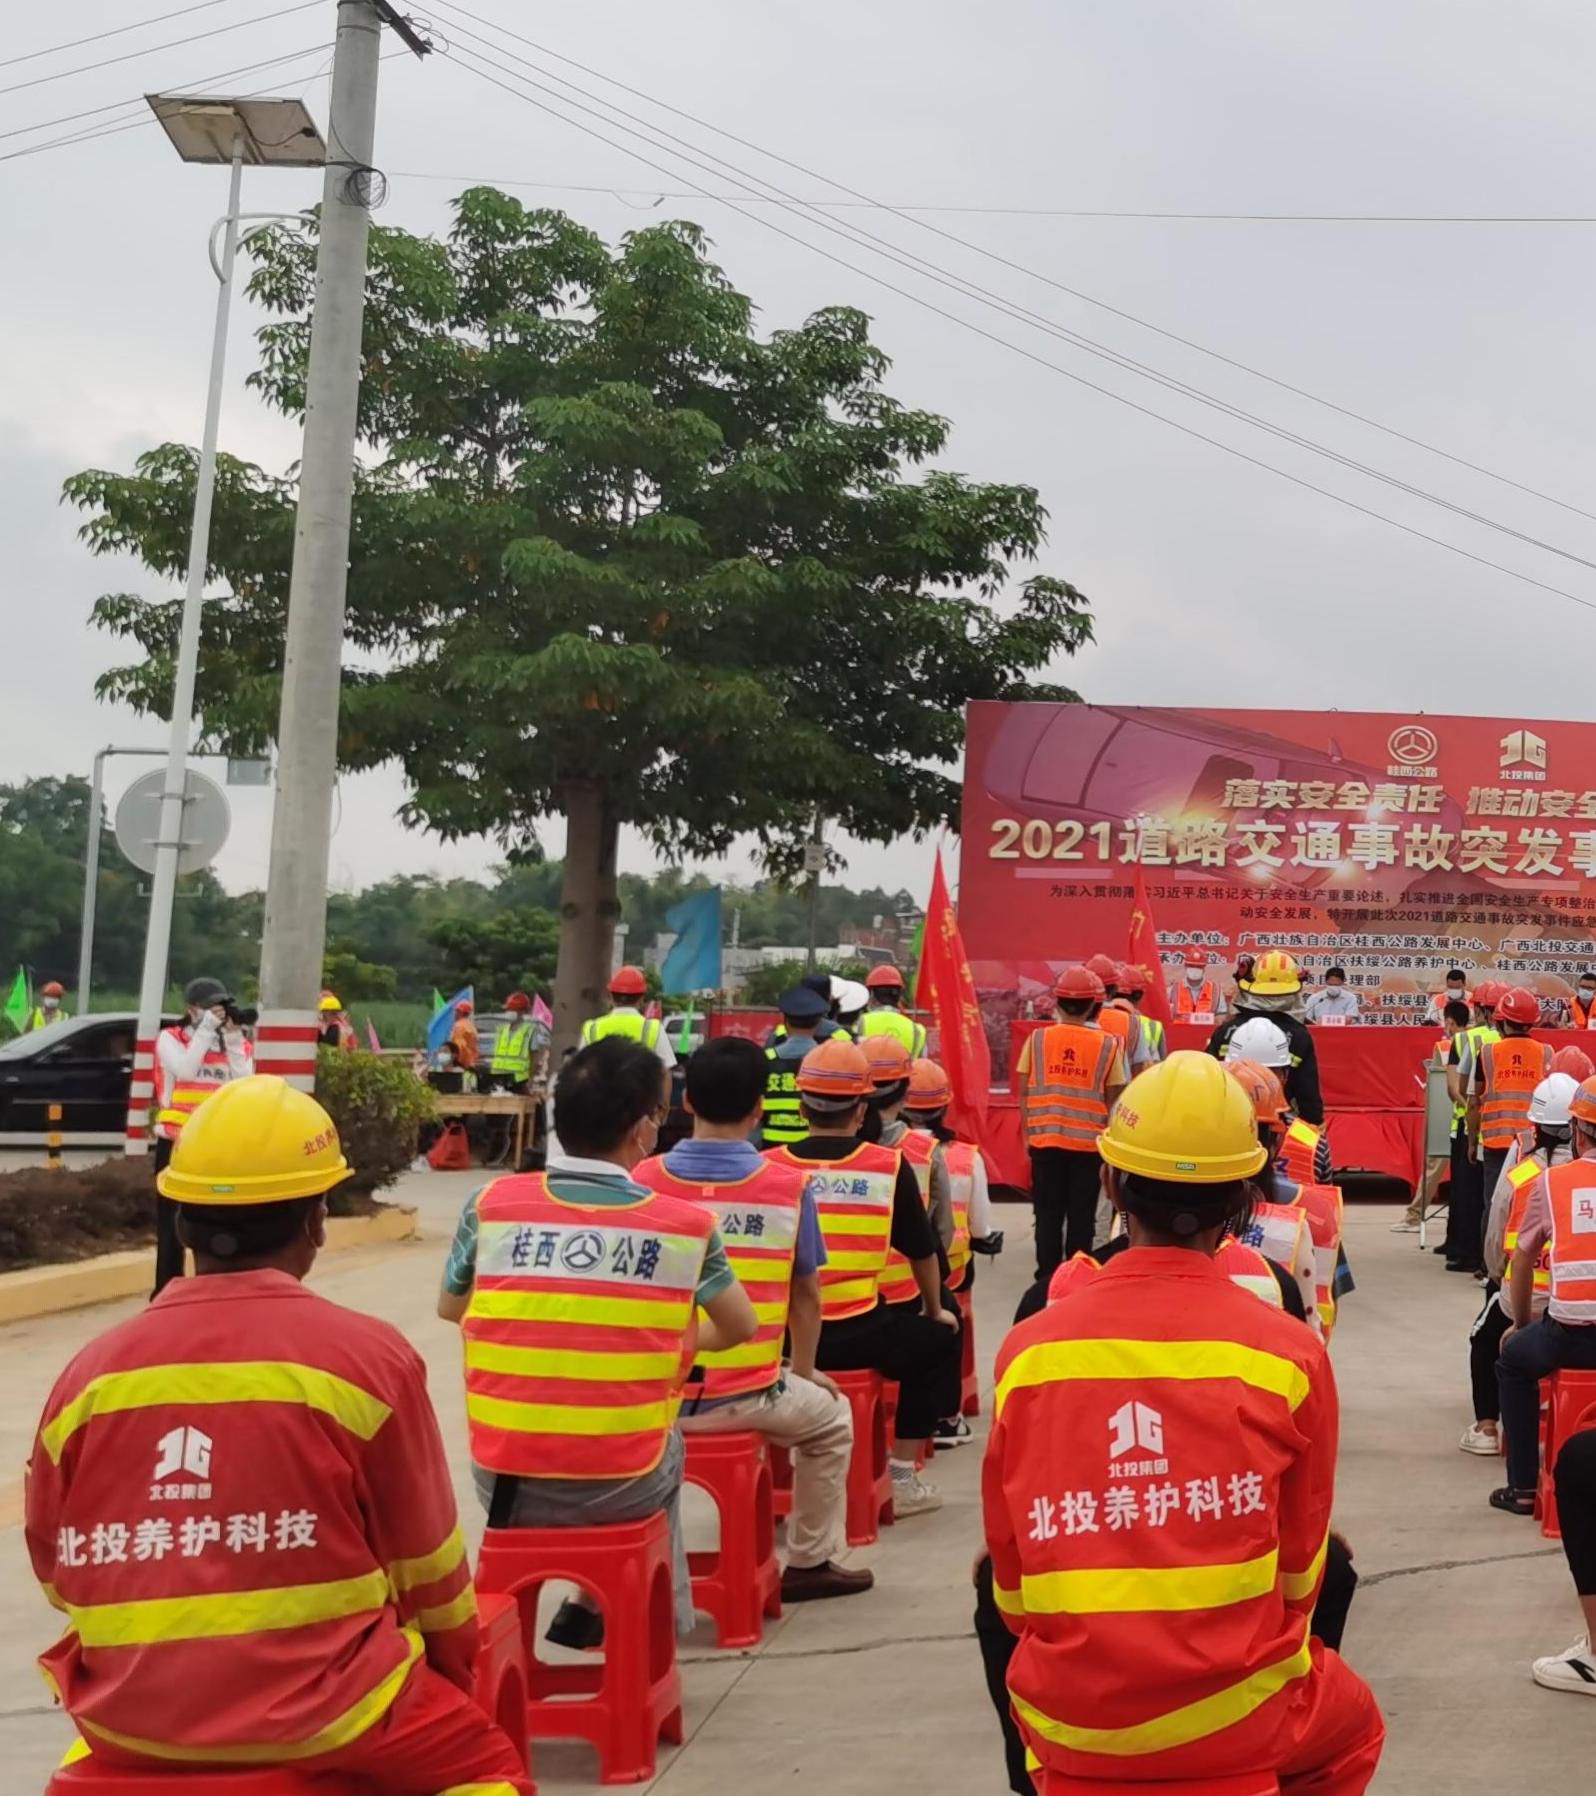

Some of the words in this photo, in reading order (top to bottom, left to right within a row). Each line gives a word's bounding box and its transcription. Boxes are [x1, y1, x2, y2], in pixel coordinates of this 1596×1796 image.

[1387, 765, 1438, 778] 桂西公路
[1499, 769, 1547, 782] 北投集团
[1221, 779, 1445, 813] 落实安全责任
[832, 1178, 870, 1196] 公路
[722, 1212, 766, 1238] 公路
[511, 1230, 561, 1269] 桂西
[611, 1235, 663, 1281] 公路
[1108, 1458, 1169, 1479] 北投集团
[149, 1484, 213, 1502] 北投集团
[1028, 1472, 1267, 1542] 北投养护科技
[57, 1509, 319, 1568] 北投养护科技
